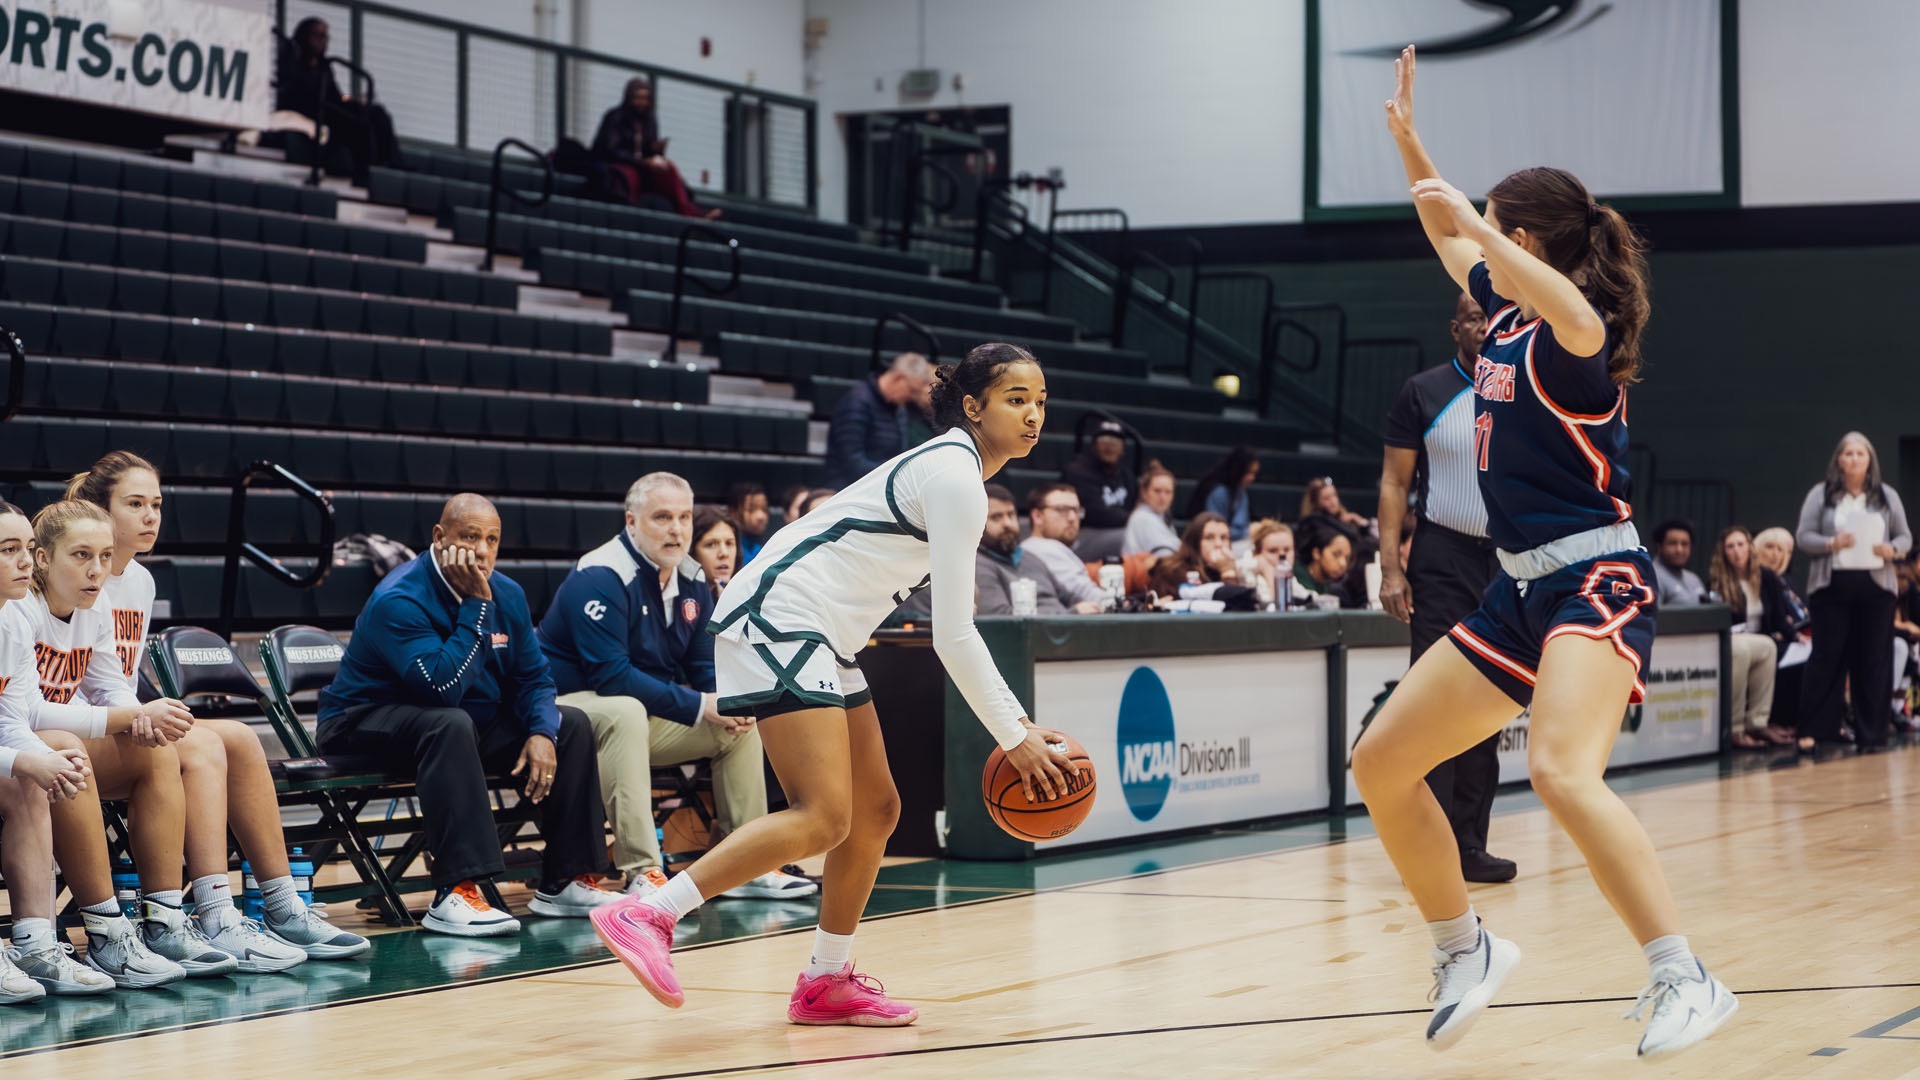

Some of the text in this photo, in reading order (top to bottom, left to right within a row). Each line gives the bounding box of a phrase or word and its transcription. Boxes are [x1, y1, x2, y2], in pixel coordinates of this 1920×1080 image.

[176, 649, 232, 663] MUSTANGS
[286, 647, 345, 662] MUSTANGS
[1123, 741, 1174, 784] NCAA
[1180, 736, 1250, 776] Division III
